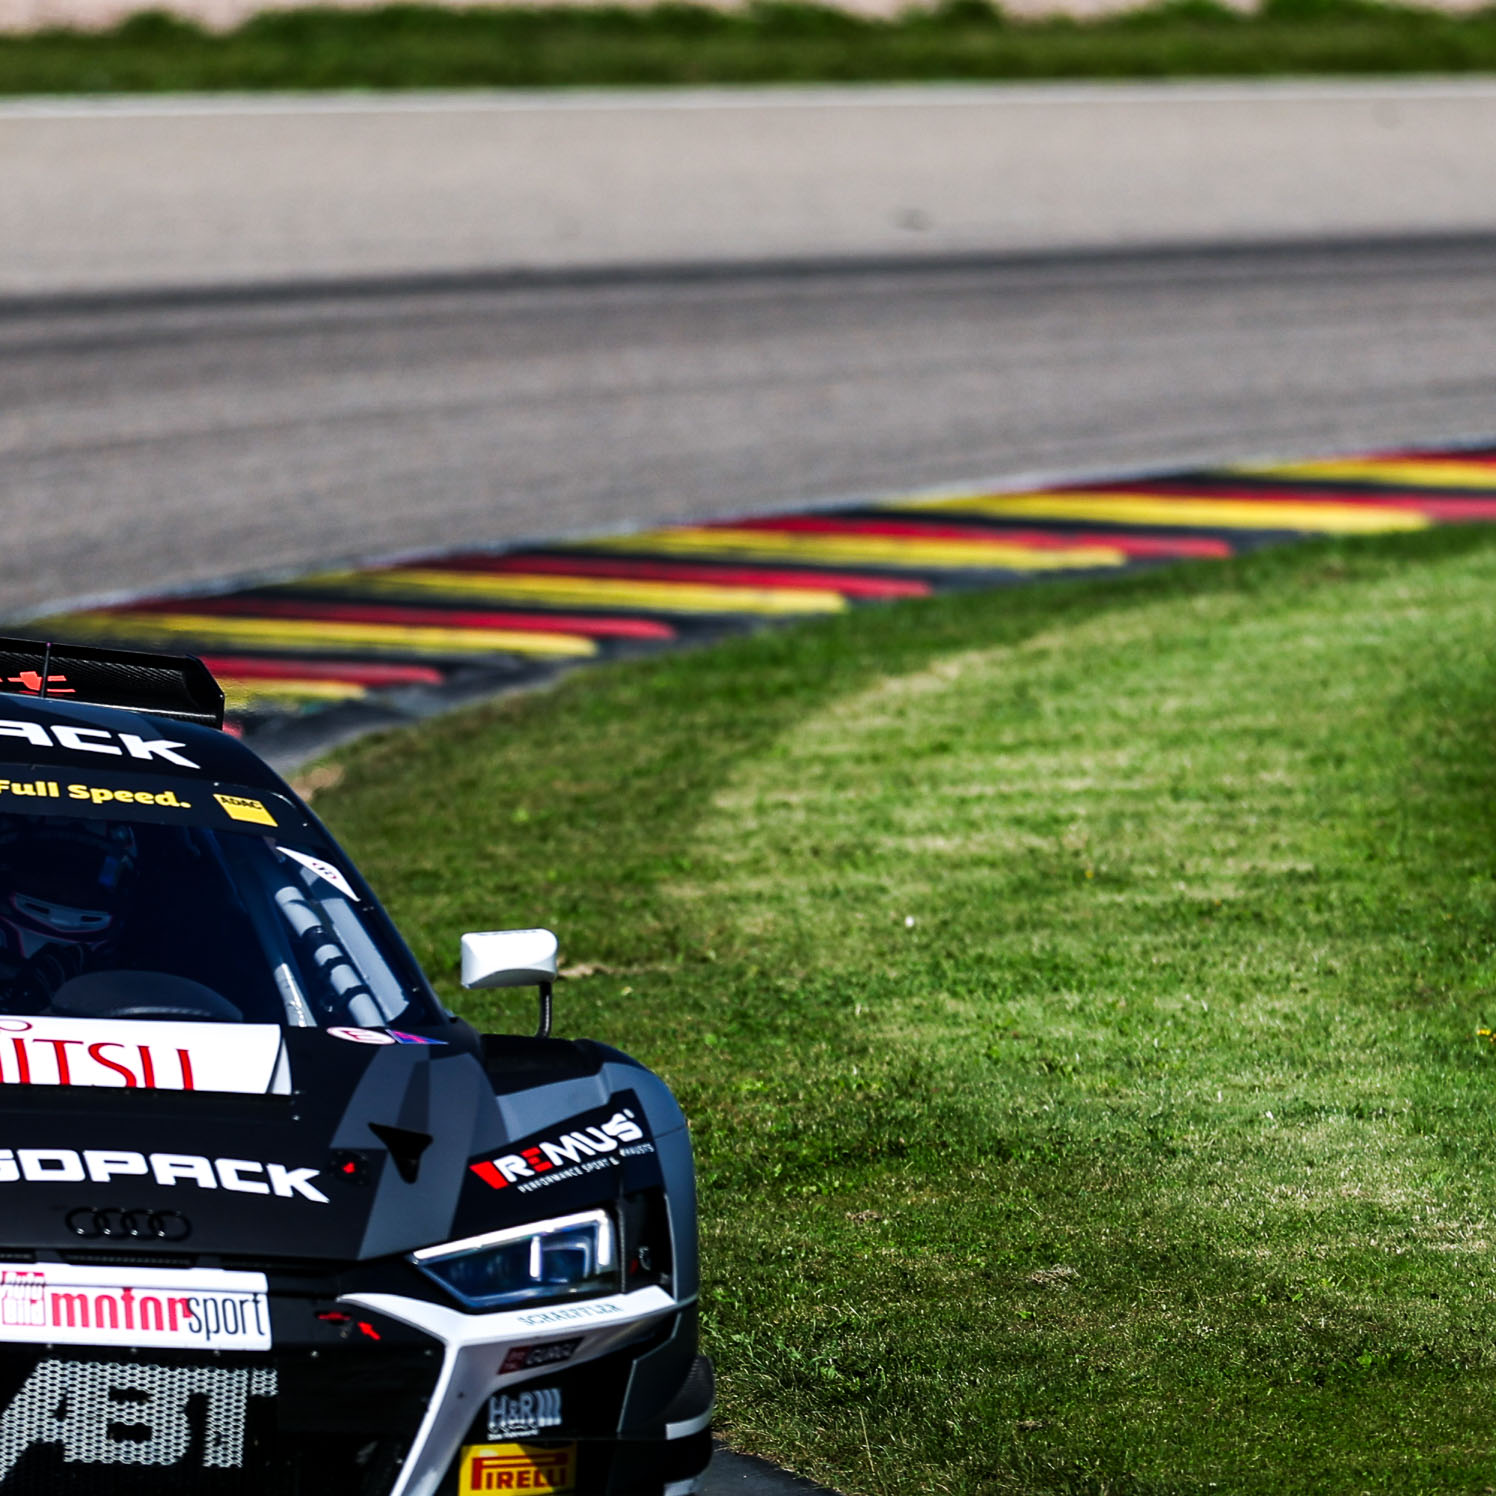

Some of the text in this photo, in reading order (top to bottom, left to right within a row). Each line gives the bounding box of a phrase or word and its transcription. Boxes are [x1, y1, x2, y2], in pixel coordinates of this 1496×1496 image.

[67, 784, 192, 809] Speed.
[219, 795, 263, 811] ADAC
[492, 1112, 644, 1183] REMUS
[471, 1453, 568, 1491] PIRELLI
